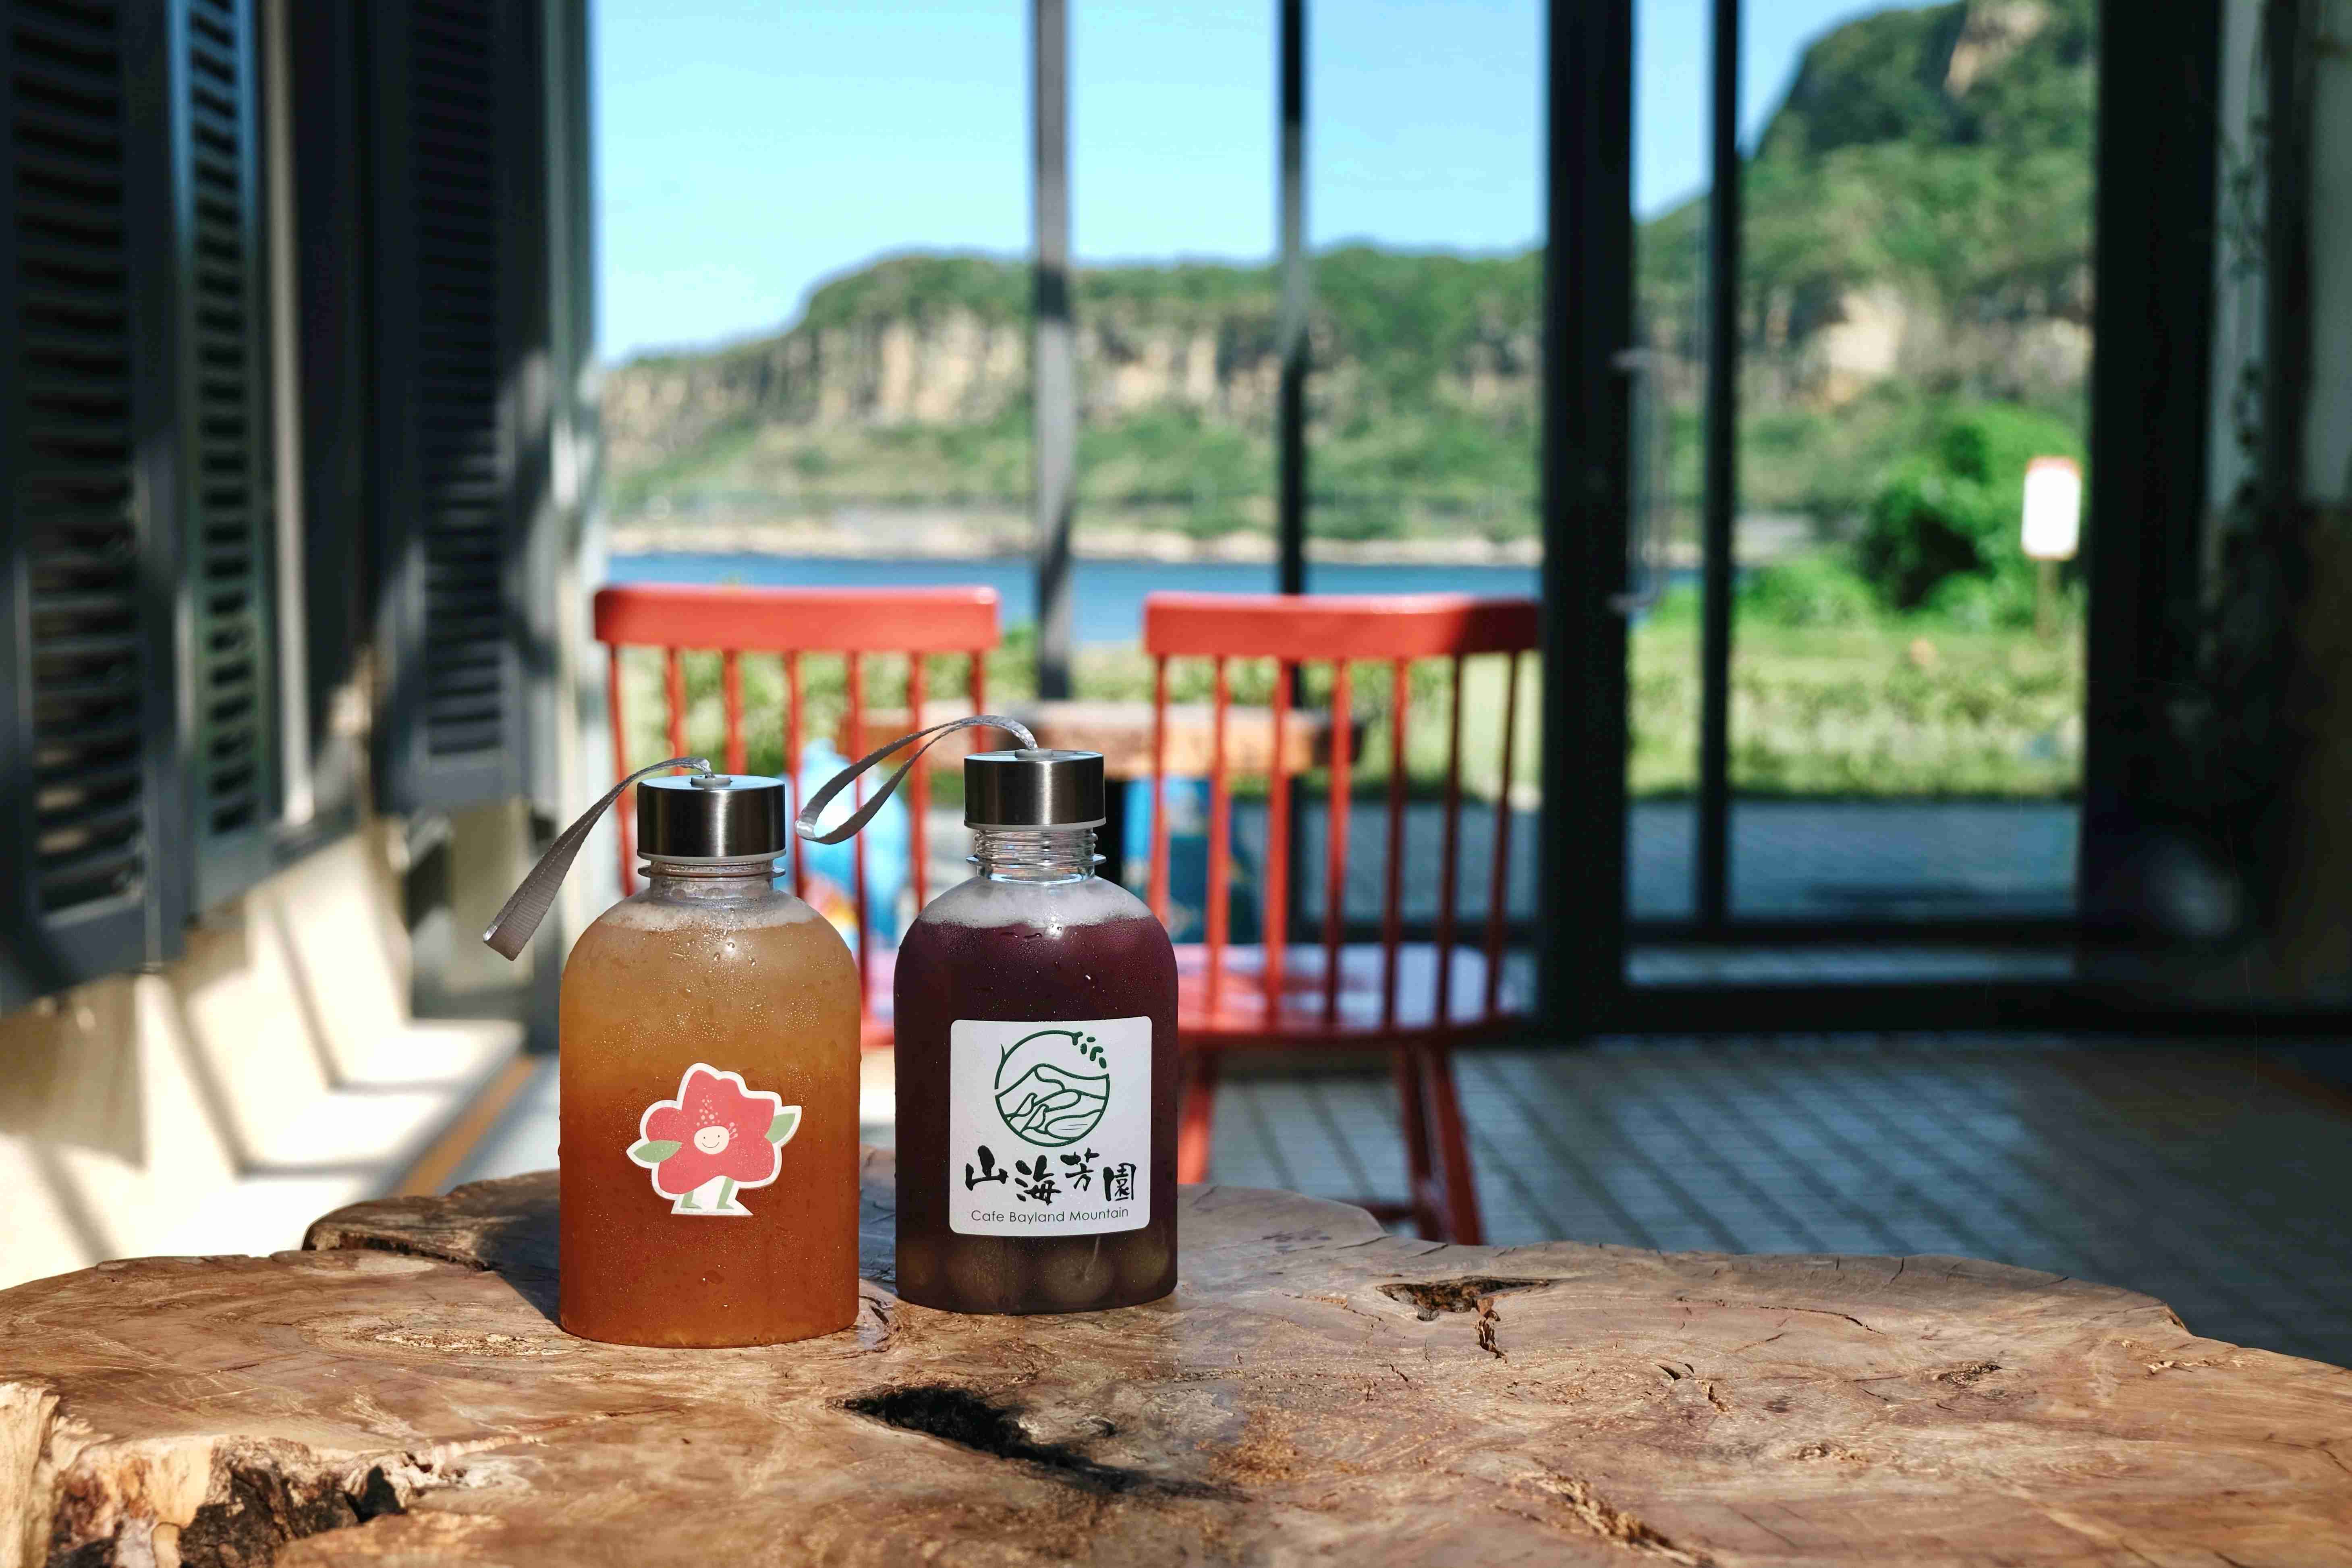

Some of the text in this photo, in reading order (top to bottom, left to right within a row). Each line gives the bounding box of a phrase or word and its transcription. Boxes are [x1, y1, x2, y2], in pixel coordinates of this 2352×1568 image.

[965, 1145, 1137, 1206] 山海芳園
[971, 1207, 1128, 1225] Cafe Bayland Mountain
